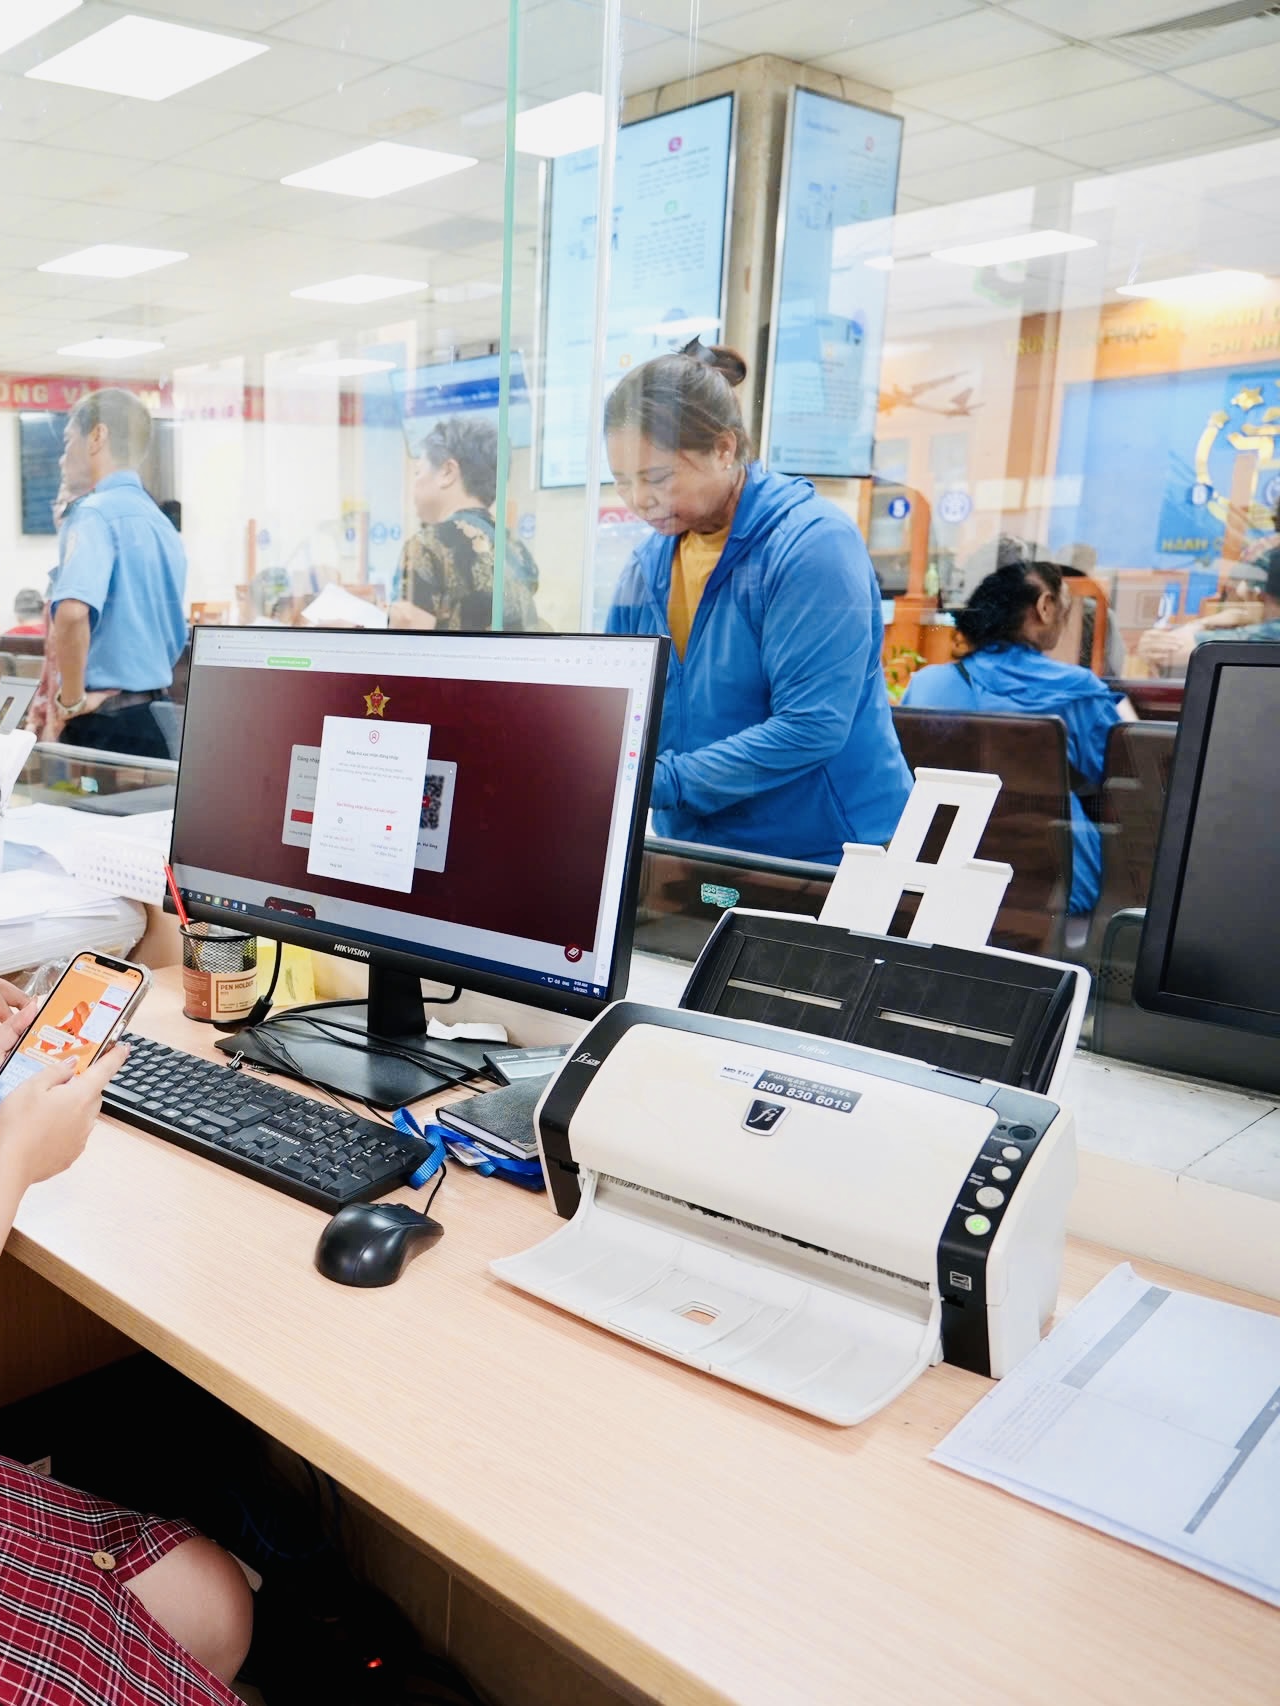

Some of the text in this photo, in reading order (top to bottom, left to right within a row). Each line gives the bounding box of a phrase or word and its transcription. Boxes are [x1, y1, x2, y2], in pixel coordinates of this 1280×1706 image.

[333, 943, 371, 959] HIKVISION
[220, 983, 234, 991] PEN
[757, 1080, 784, 1094] 800
[785, 1087, 813, 1101] 830
[815, 1095, 852, 1111] 6019
[257, 1126, 283, 1139] GOLDEN
[989, 1135, 1015, 1145] Function
[979, 1154, 997, 1163] Send
[970, 1172, 986, 1181] Scan
[955, 1203, 976, 1213] Power
